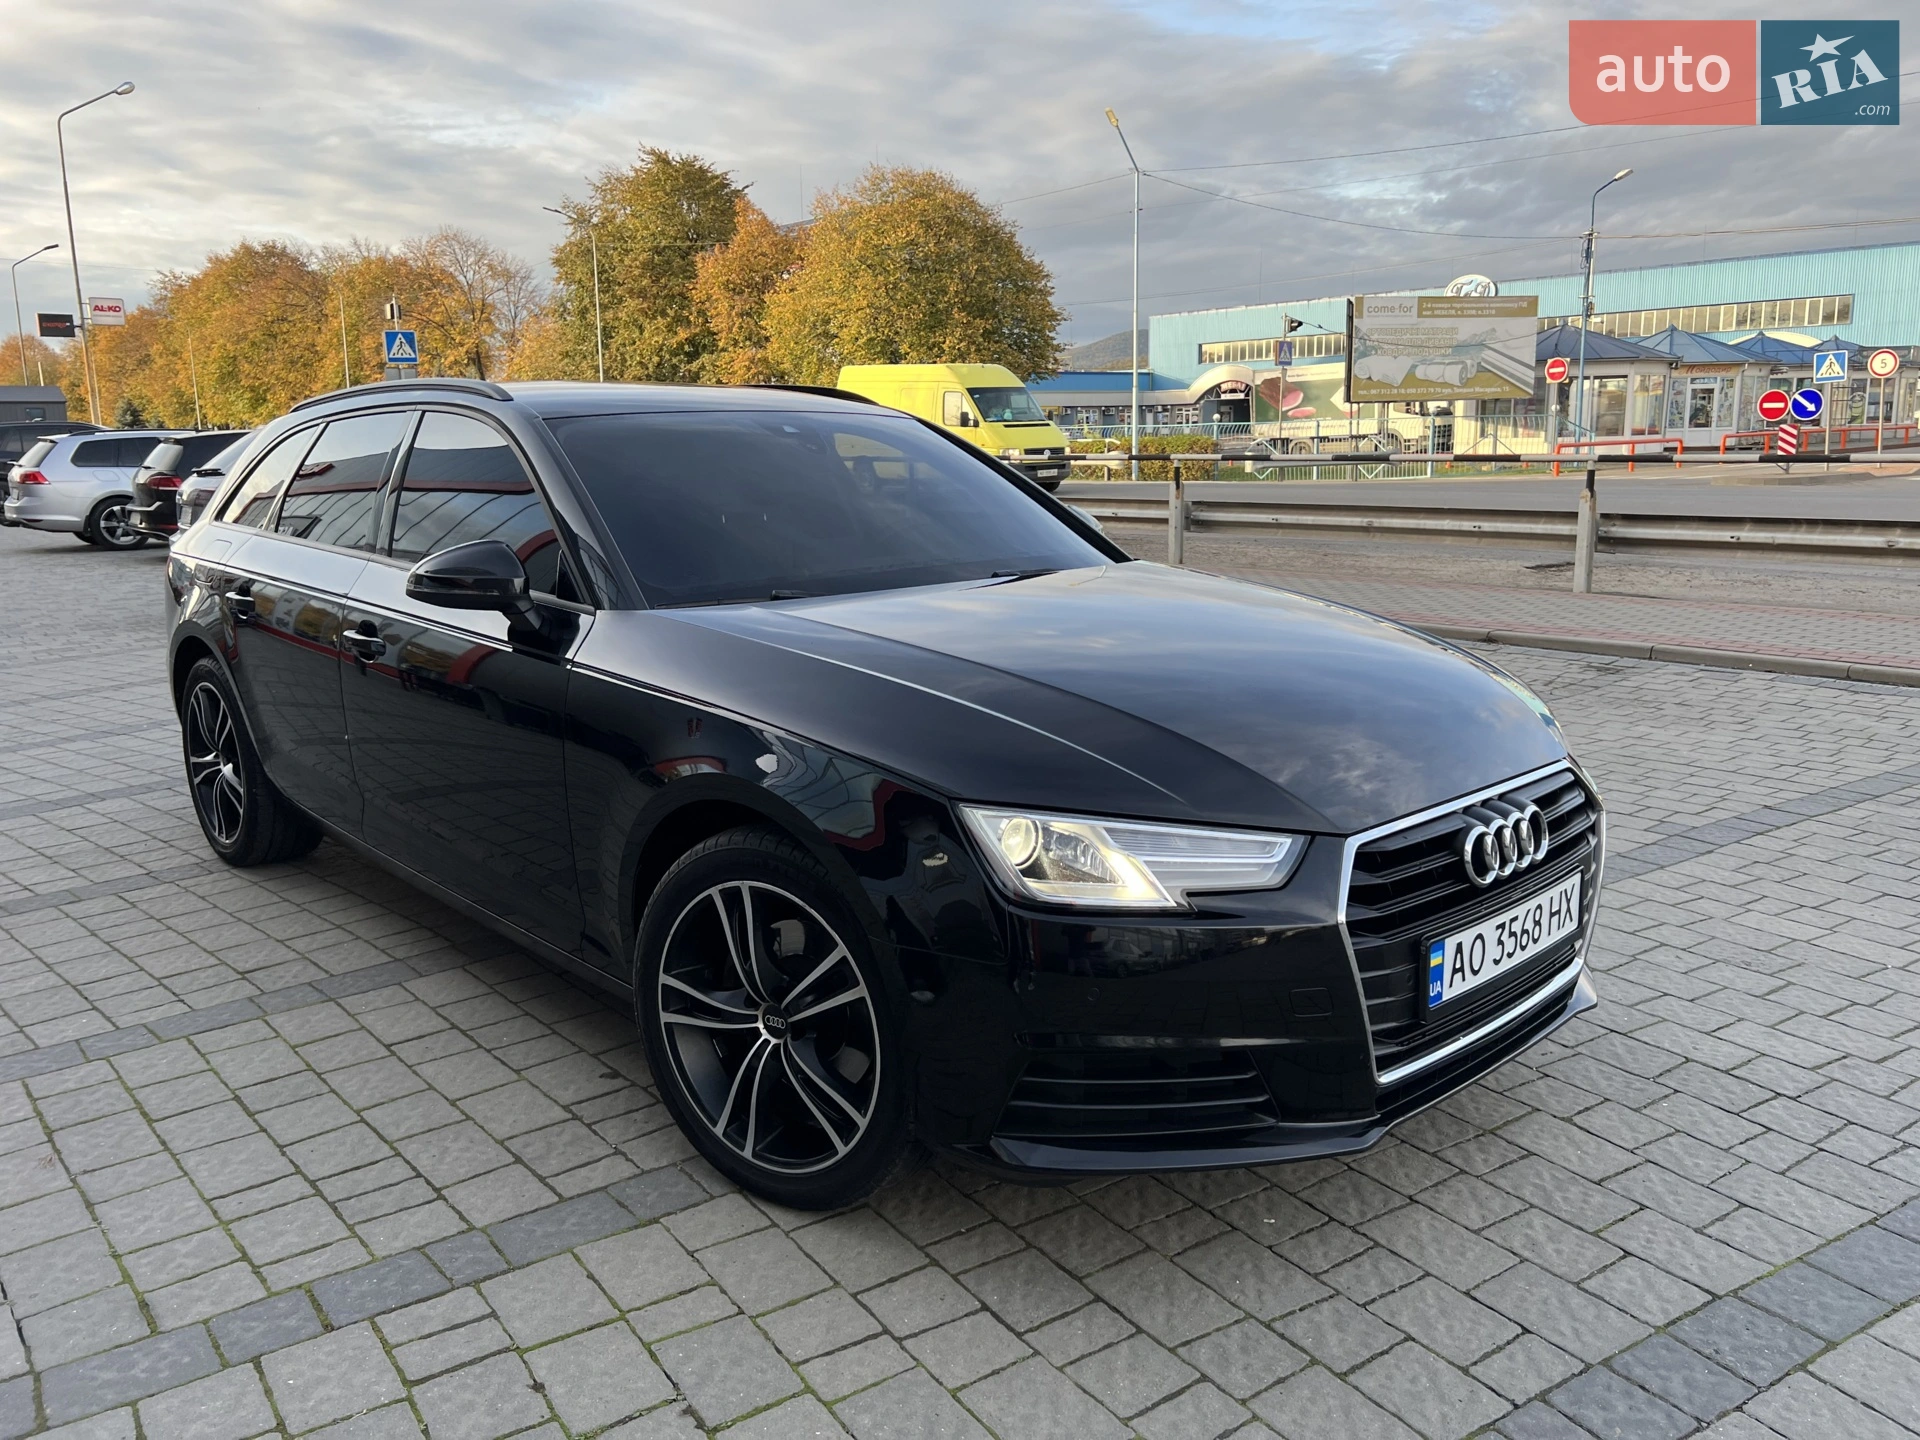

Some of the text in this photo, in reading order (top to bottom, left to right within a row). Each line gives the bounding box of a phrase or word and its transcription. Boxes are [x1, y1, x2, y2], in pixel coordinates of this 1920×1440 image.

[1880, 358, 1888, 369] 5
[1449, 883, 1576, 989] AO 3568 HX
[1429, 983, 1443, 997] UA
